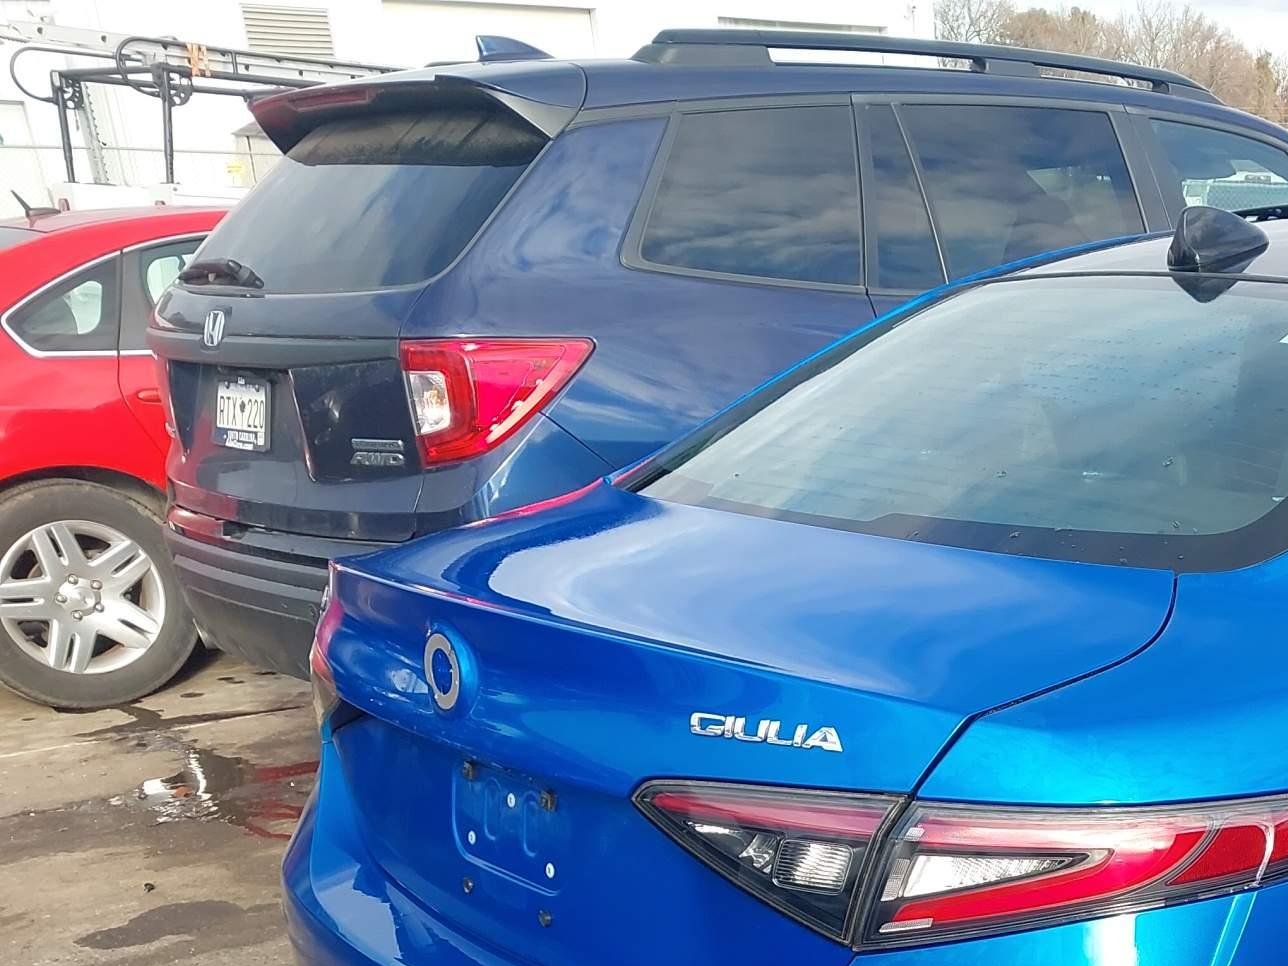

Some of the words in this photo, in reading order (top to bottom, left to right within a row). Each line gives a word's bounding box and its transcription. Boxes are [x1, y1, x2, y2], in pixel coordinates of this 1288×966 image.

[218, 395, 238, 427] RTX
[246, 398, 265, 429] 220
[350, 451, 404, 466] AWD
[690, 711, 844, 753] GIULIA
